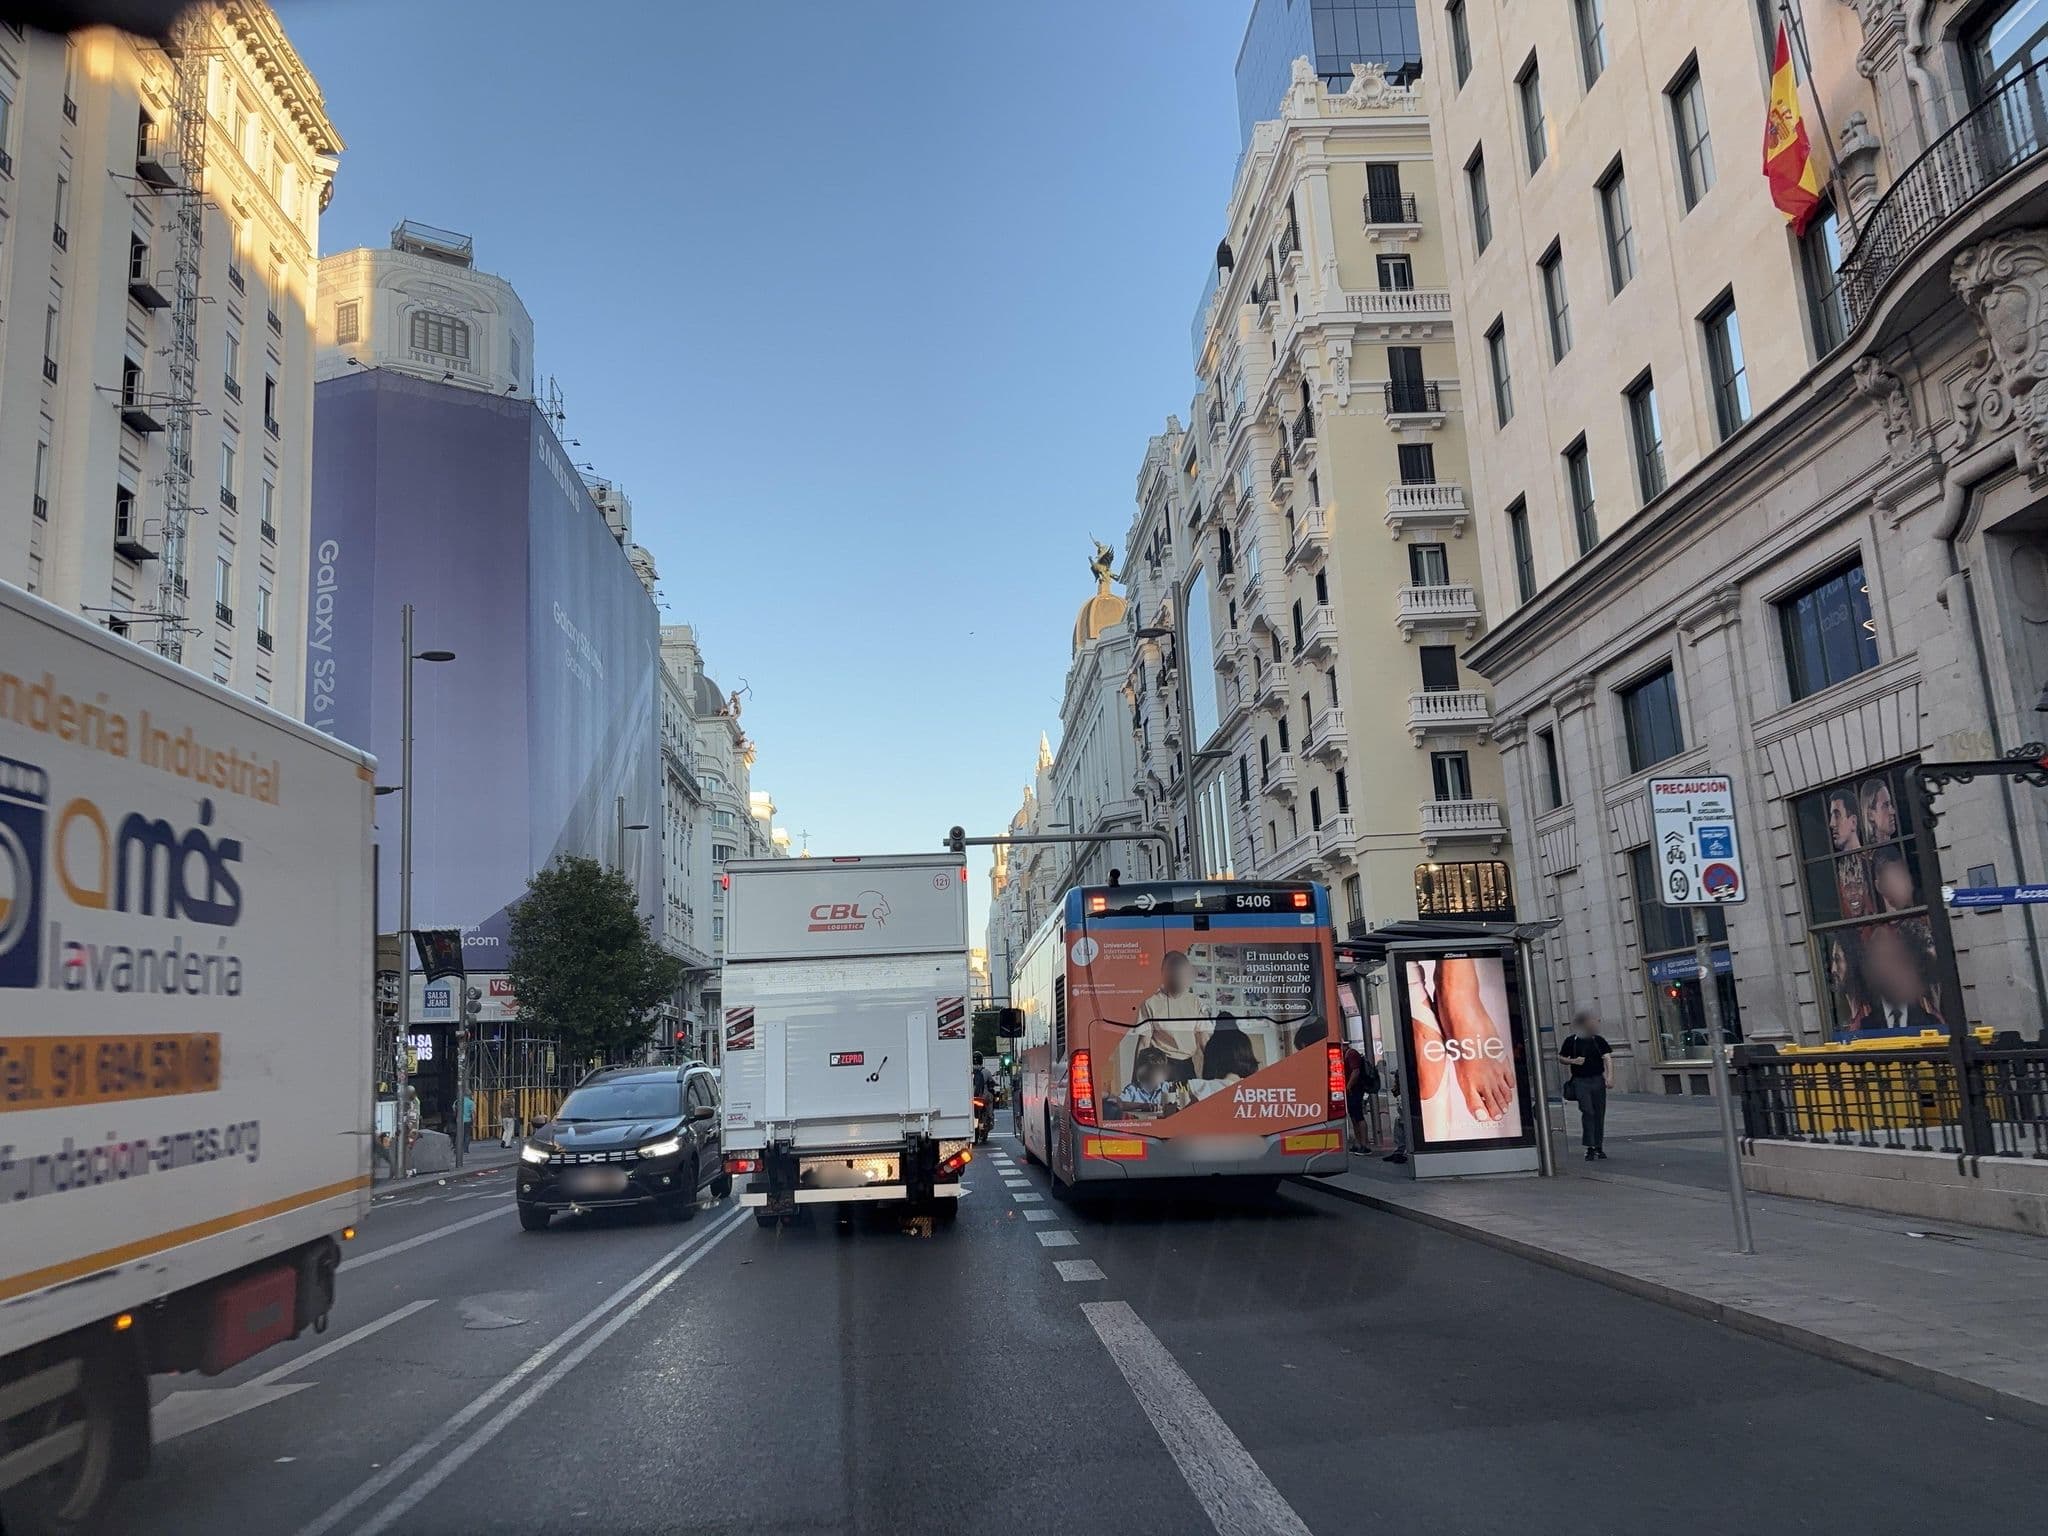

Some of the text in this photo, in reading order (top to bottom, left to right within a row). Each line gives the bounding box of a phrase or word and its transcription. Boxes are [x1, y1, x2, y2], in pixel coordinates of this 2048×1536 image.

[537, 434, 580, 513] SAMSUNG
[310, 539, 340, 653] Galaxy
[313, 658, 335, 712] S26
[137, 708, 281, 806] Industrial
[935, 879, 949, 887] 121
[1193, 889, 1271, 908] 1 5406
[810, 903, 867, 921] CBL
[48, 921, 243, 997] lavandería
[1246, 950, 1309, 961] El mundo es
[1246, 962, 1310, 973] apasionante
[1228, 972, 1310, 985] para quien sabe
[427, 991, 448, 999] SALSA
[1272, 983, 1311, 994] mirarlo
[427, 1000, 448, 1008] JEANS
[1423, 1034, 1505, 1062] essie
[841, 1054, 863, 1065] ZEPRO
[1233, 1085, 1296, 1103] ÁBRETE
[1233, 1103, 1321, 1119] AL MUNDO
